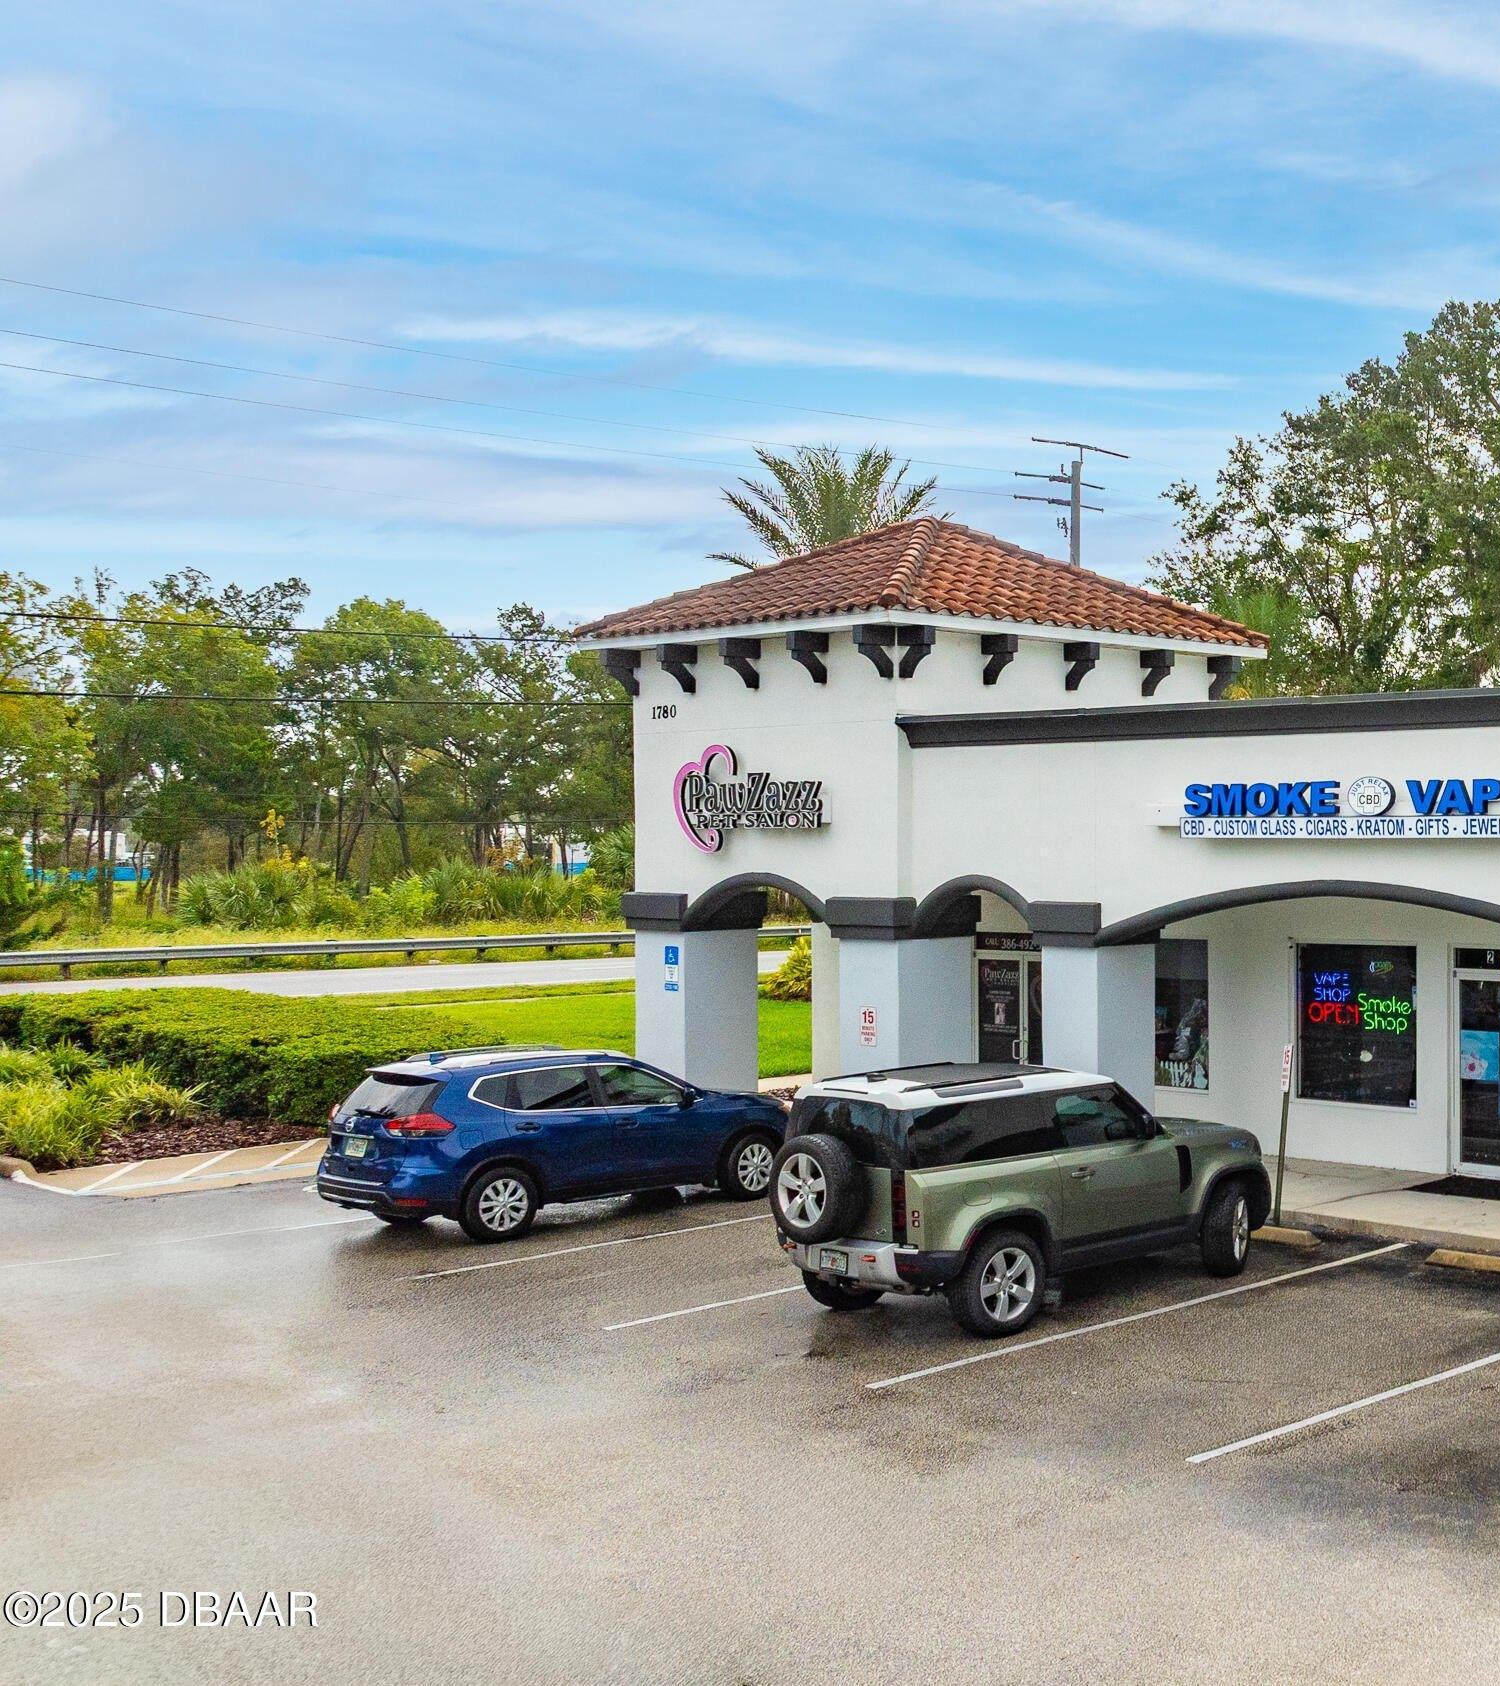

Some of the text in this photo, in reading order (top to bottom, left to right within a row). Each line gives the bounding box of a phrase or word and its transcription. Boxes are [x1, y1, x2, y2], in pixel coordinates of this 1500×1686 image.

[651, 705, 677, 720] 1780
[686, 772, 822, 813] PawZazz
[1351, 778, 1389, 796] JUST RELAX
[1184, 781, 1340, 817] SMOKE
[1358, 794, 1380, 805] CBD
[696, 812, 822, 829] PET SALON
[1183, 819, 1205, 836] CBD
[1213, 819, 1257, 836] CUSTOM
[1260, 819, 1296, 836] GLASS
[1305, 819, 1348, 836] CIGARS
[1356, 818, 1405, 836] KRATOM
[1415, 818, 1450, 836] GIFTS
[1486, 950, 1495, 964] 2
[1313, 973, 1350, 986] VAPE
[1313, 987, 1351, 1002] SHOP
[1357, 993, 1412, 1015] Smoke
[862, 1010, 874, 1024] 15
[1363, 1012, 1408, 1035] Shop
